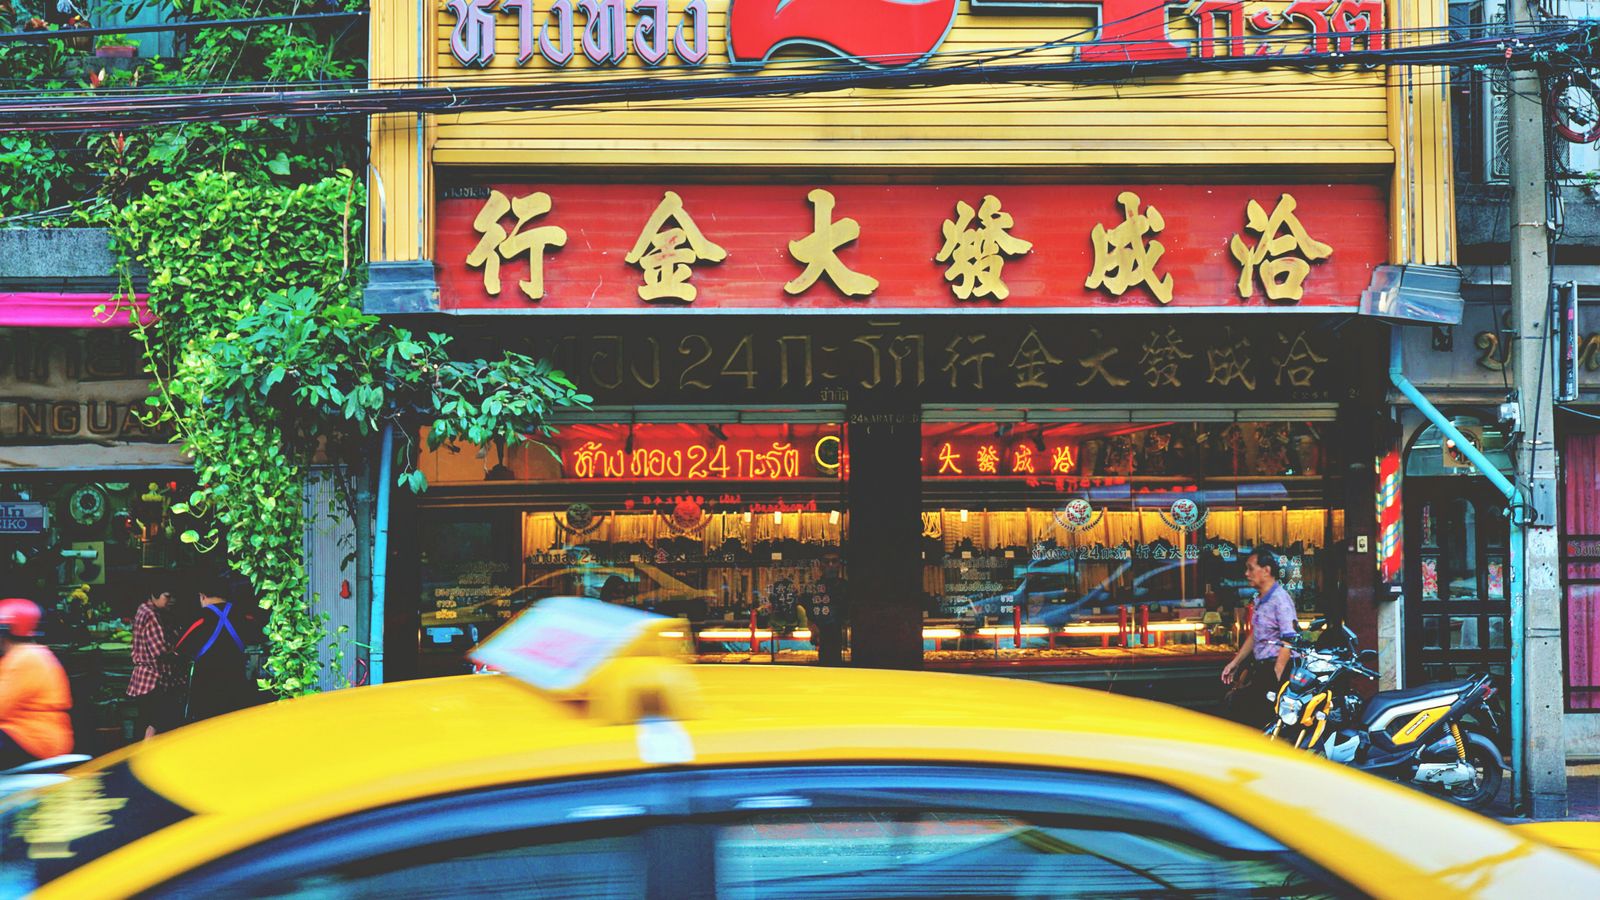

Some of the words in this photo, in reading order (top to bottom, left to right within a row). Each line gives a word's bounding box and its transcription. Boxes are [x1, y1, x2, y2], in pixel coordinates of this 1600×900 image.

[677, 334, 759, 390] 24
[775, 319, 926, 390] กะรัต
[686, 444, 731, 479] 24
[736, 441, 800, 479] กะรัต
[0, 518, 28, 530] IKO
[1079, 544, 1100, 559] 24
